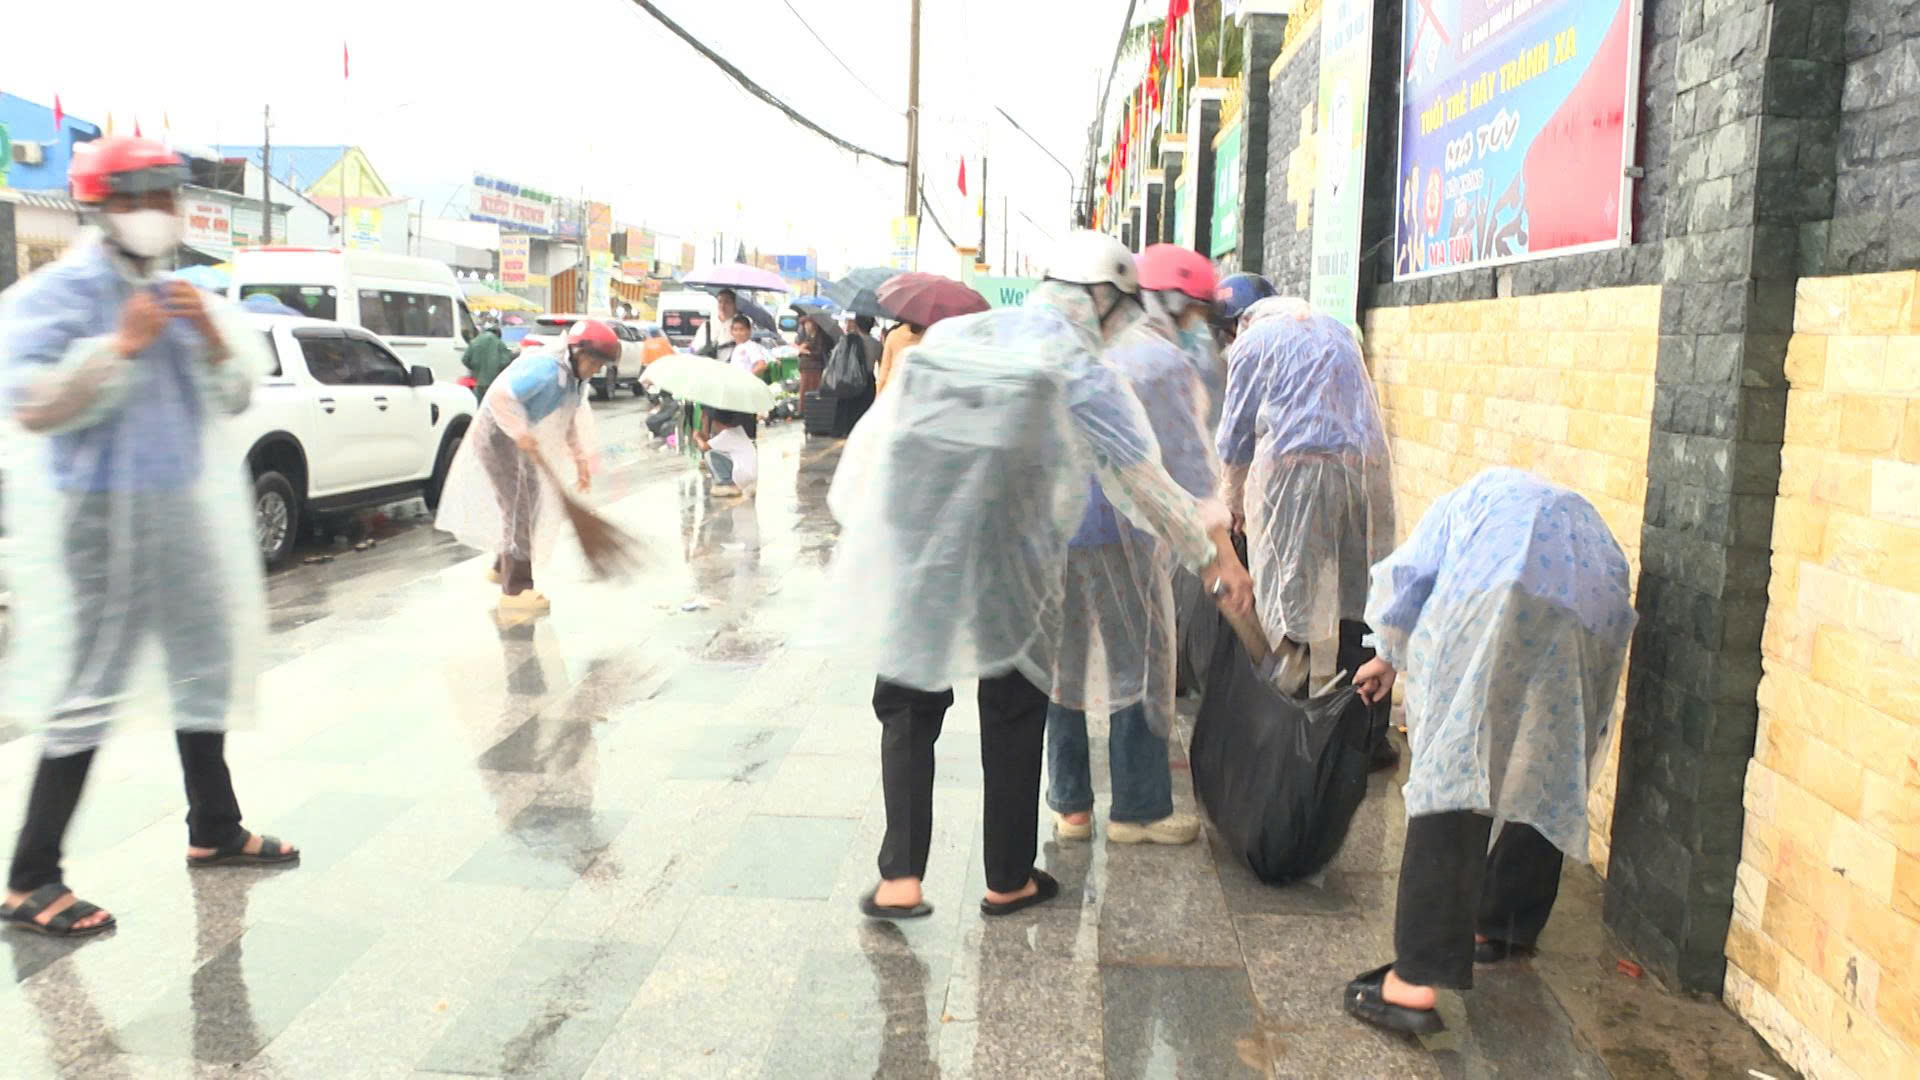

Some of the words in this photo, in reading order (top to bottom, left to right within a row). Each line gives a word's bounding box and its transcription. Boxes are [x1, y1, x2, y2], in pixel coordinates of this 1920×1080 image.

[1420, 95, 1443, 136] TUỔI
[1446, 80, 1467, 121] TRẺ
[1470, 72, 1497, 111] HÃY
[1499, 40, 1549, 93] TRÁNH
[1552, 26, 1577, 65] XA
